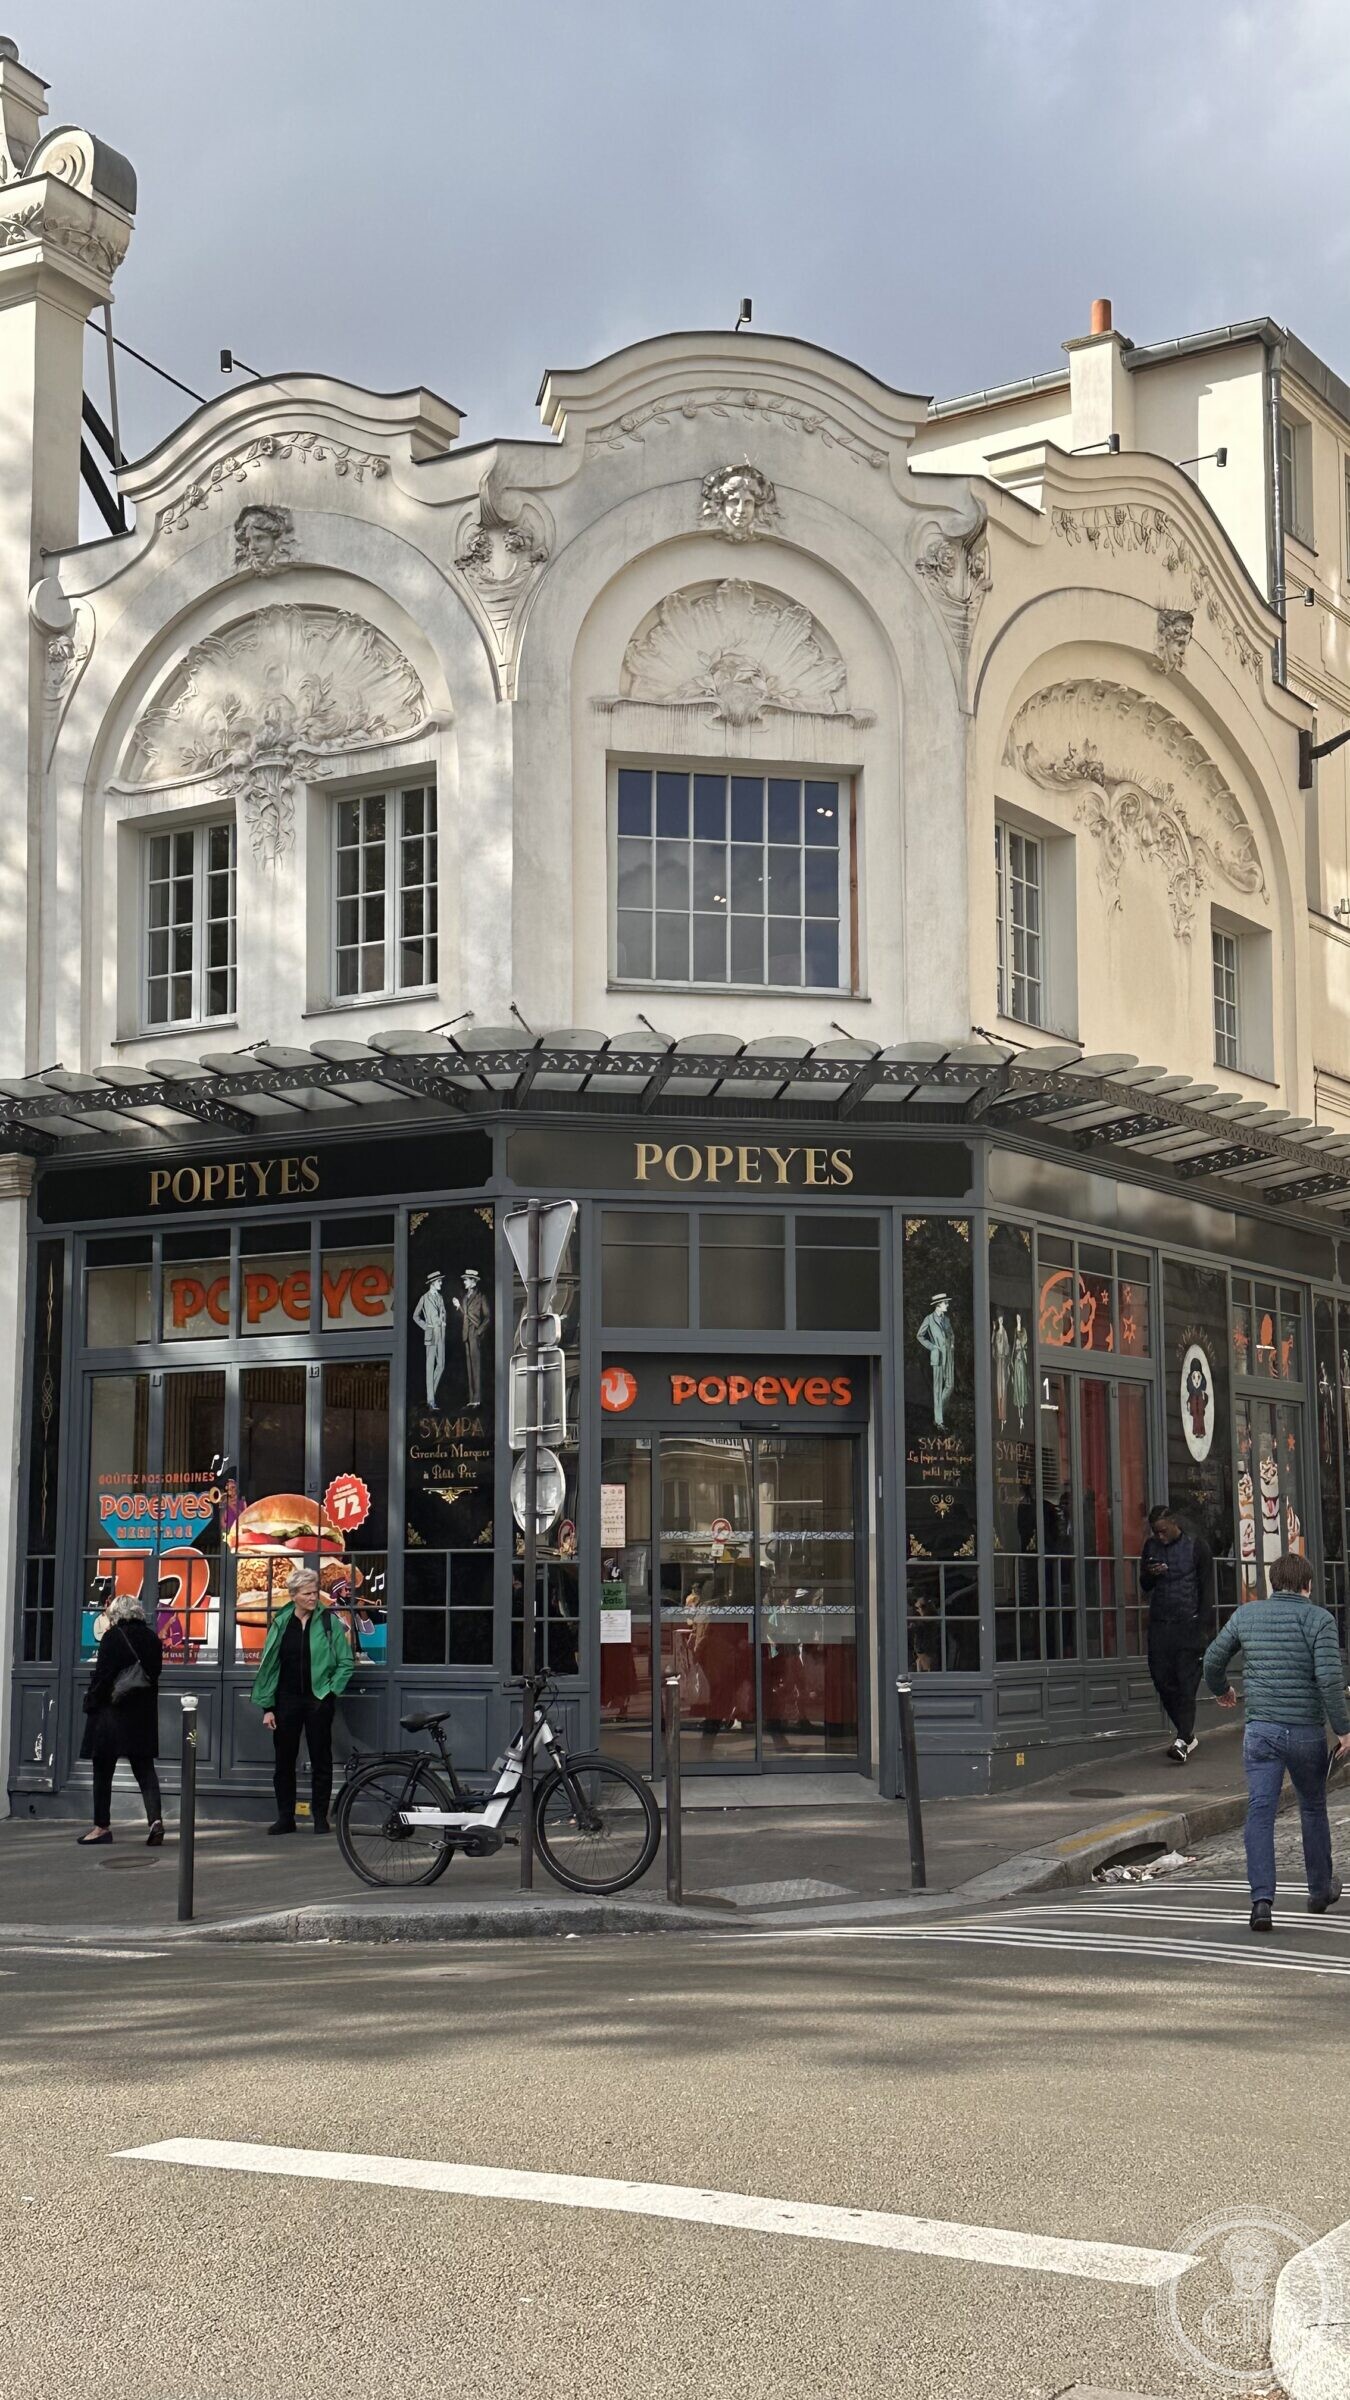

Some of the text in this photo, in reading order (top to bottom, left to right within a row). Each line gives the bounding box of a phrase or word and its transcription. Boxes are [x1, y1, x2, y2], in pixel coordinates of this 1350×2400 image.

[634, 1142, 854, 1186] POPEYES
[149, 1155, 320, 1206] POPEYES
[420, 1417, 485, 1438] SYMPA
[918, 1437, 964, 1450] SYMPA
[165, 1472, 215, 1483] ORIGINES
[334, 1494, 362, 1520] 72
